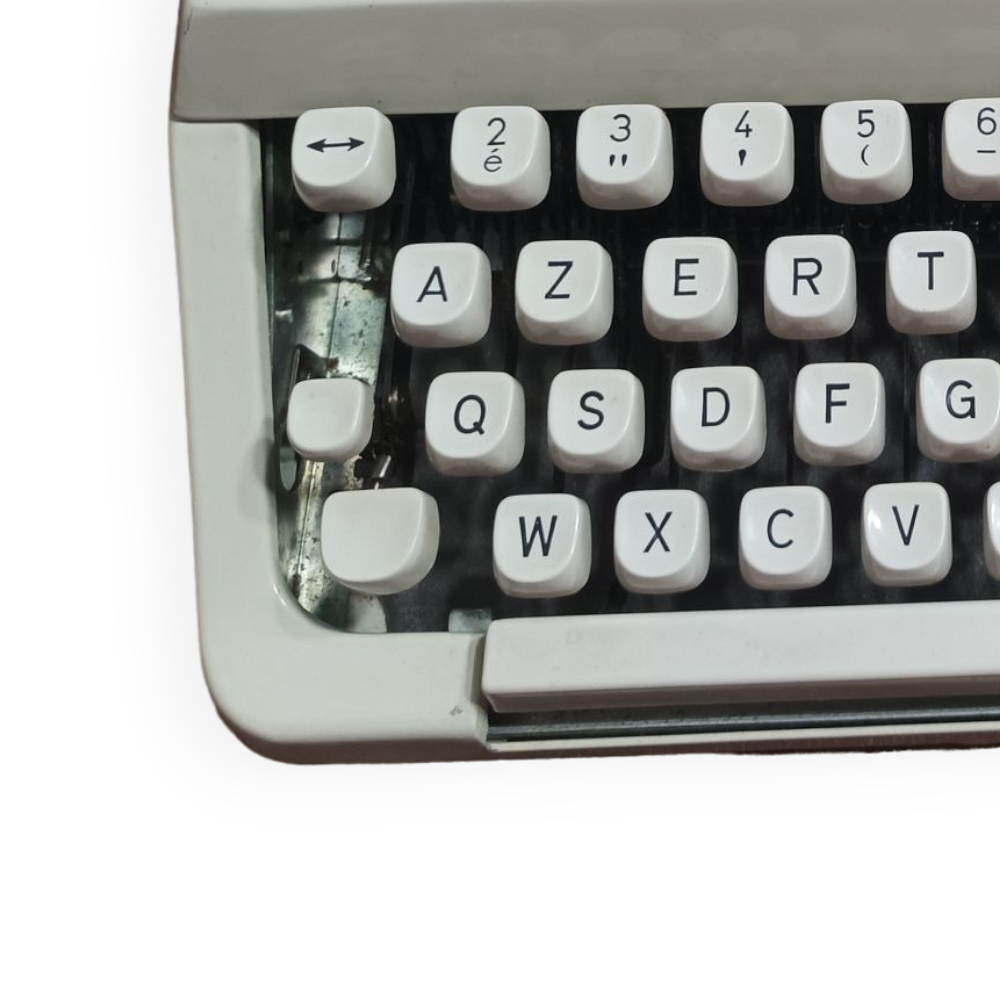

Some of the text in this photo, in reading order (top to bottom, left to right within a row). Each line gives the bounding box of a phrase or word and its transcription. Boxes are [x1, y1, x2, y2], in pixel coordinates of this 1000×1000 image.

[486, 116, 506, 147] 2
[609, 113, 631, 143] 3
[734, 109, 753, 139] 4
[857, 109, 876, 139] 5
[976, 106, 997, 136] 6
[483, 148, 503, 173] é
[416, 265, 448, 303] A
[544, 260, 574, 300] Z
[673, 258, 700, 297] E
[792, 257, 823, 296] R
[917, 251, 945, 291] T
[453, 394, 487, 435] Q
[577, 390, 605, 431] S
[701, 386, 731, 428] D
[825, 382, 851, 424] F
[945, 379, 976, 420] G
[518, 515, 558, 558] W
[643, 511, 673, 553] X
[766, 508, 795, 549] C
[891, 504, 920, 547] V
